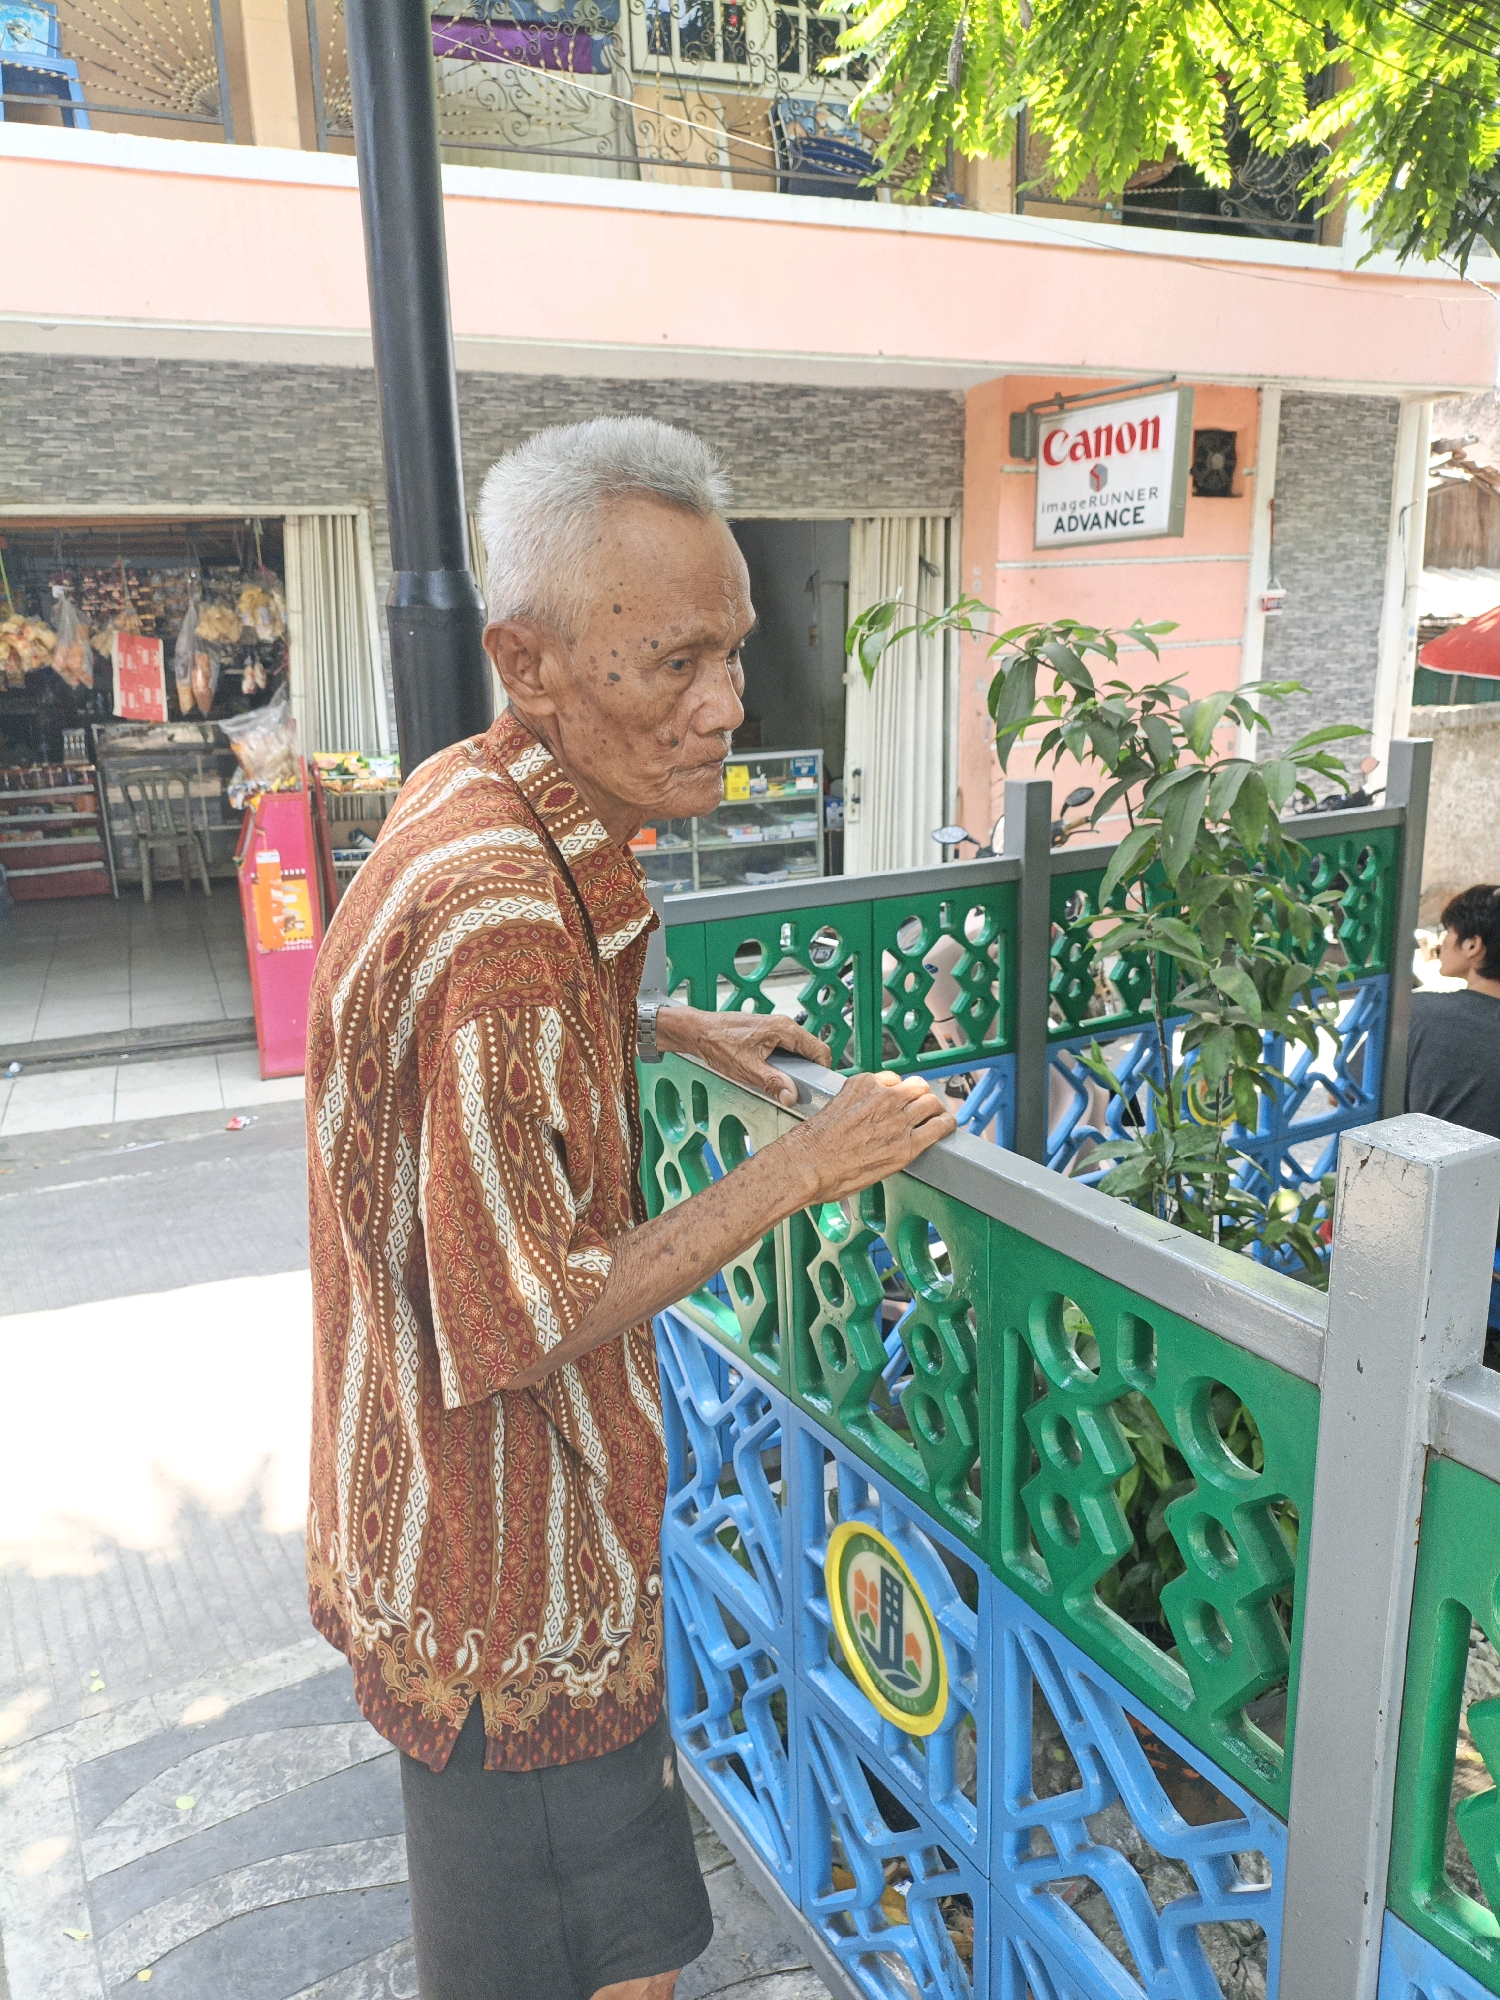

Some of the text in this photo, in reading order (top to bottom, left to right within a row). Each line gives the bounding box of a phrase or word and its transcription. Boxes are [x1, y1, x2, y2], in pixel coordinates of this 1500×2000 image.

[1042, 415, 1160, 467] Canon
[1041, 487, 1159, 513] imageRUNNER
[1053, 506, 1146, 534] ADVANCE
